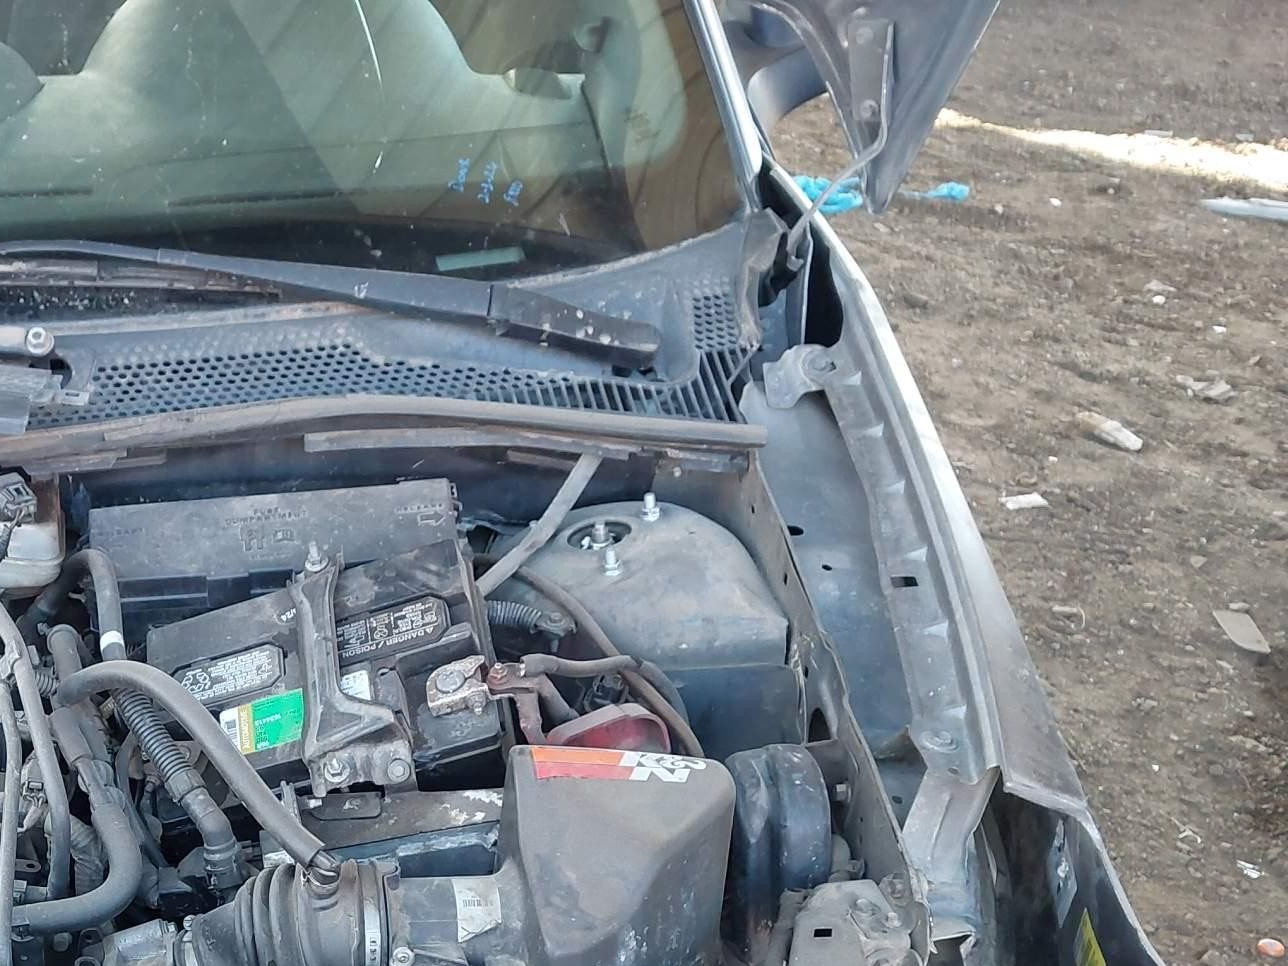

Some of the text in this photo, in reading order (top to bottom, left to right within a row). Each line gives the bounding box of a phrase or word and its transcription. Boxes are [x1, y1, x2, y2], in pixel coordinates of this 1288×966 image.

[385, 630, 425, 646] DANGER
[342, 643, 377, 658] POISON
[619, 752, 707, 783] K&N
